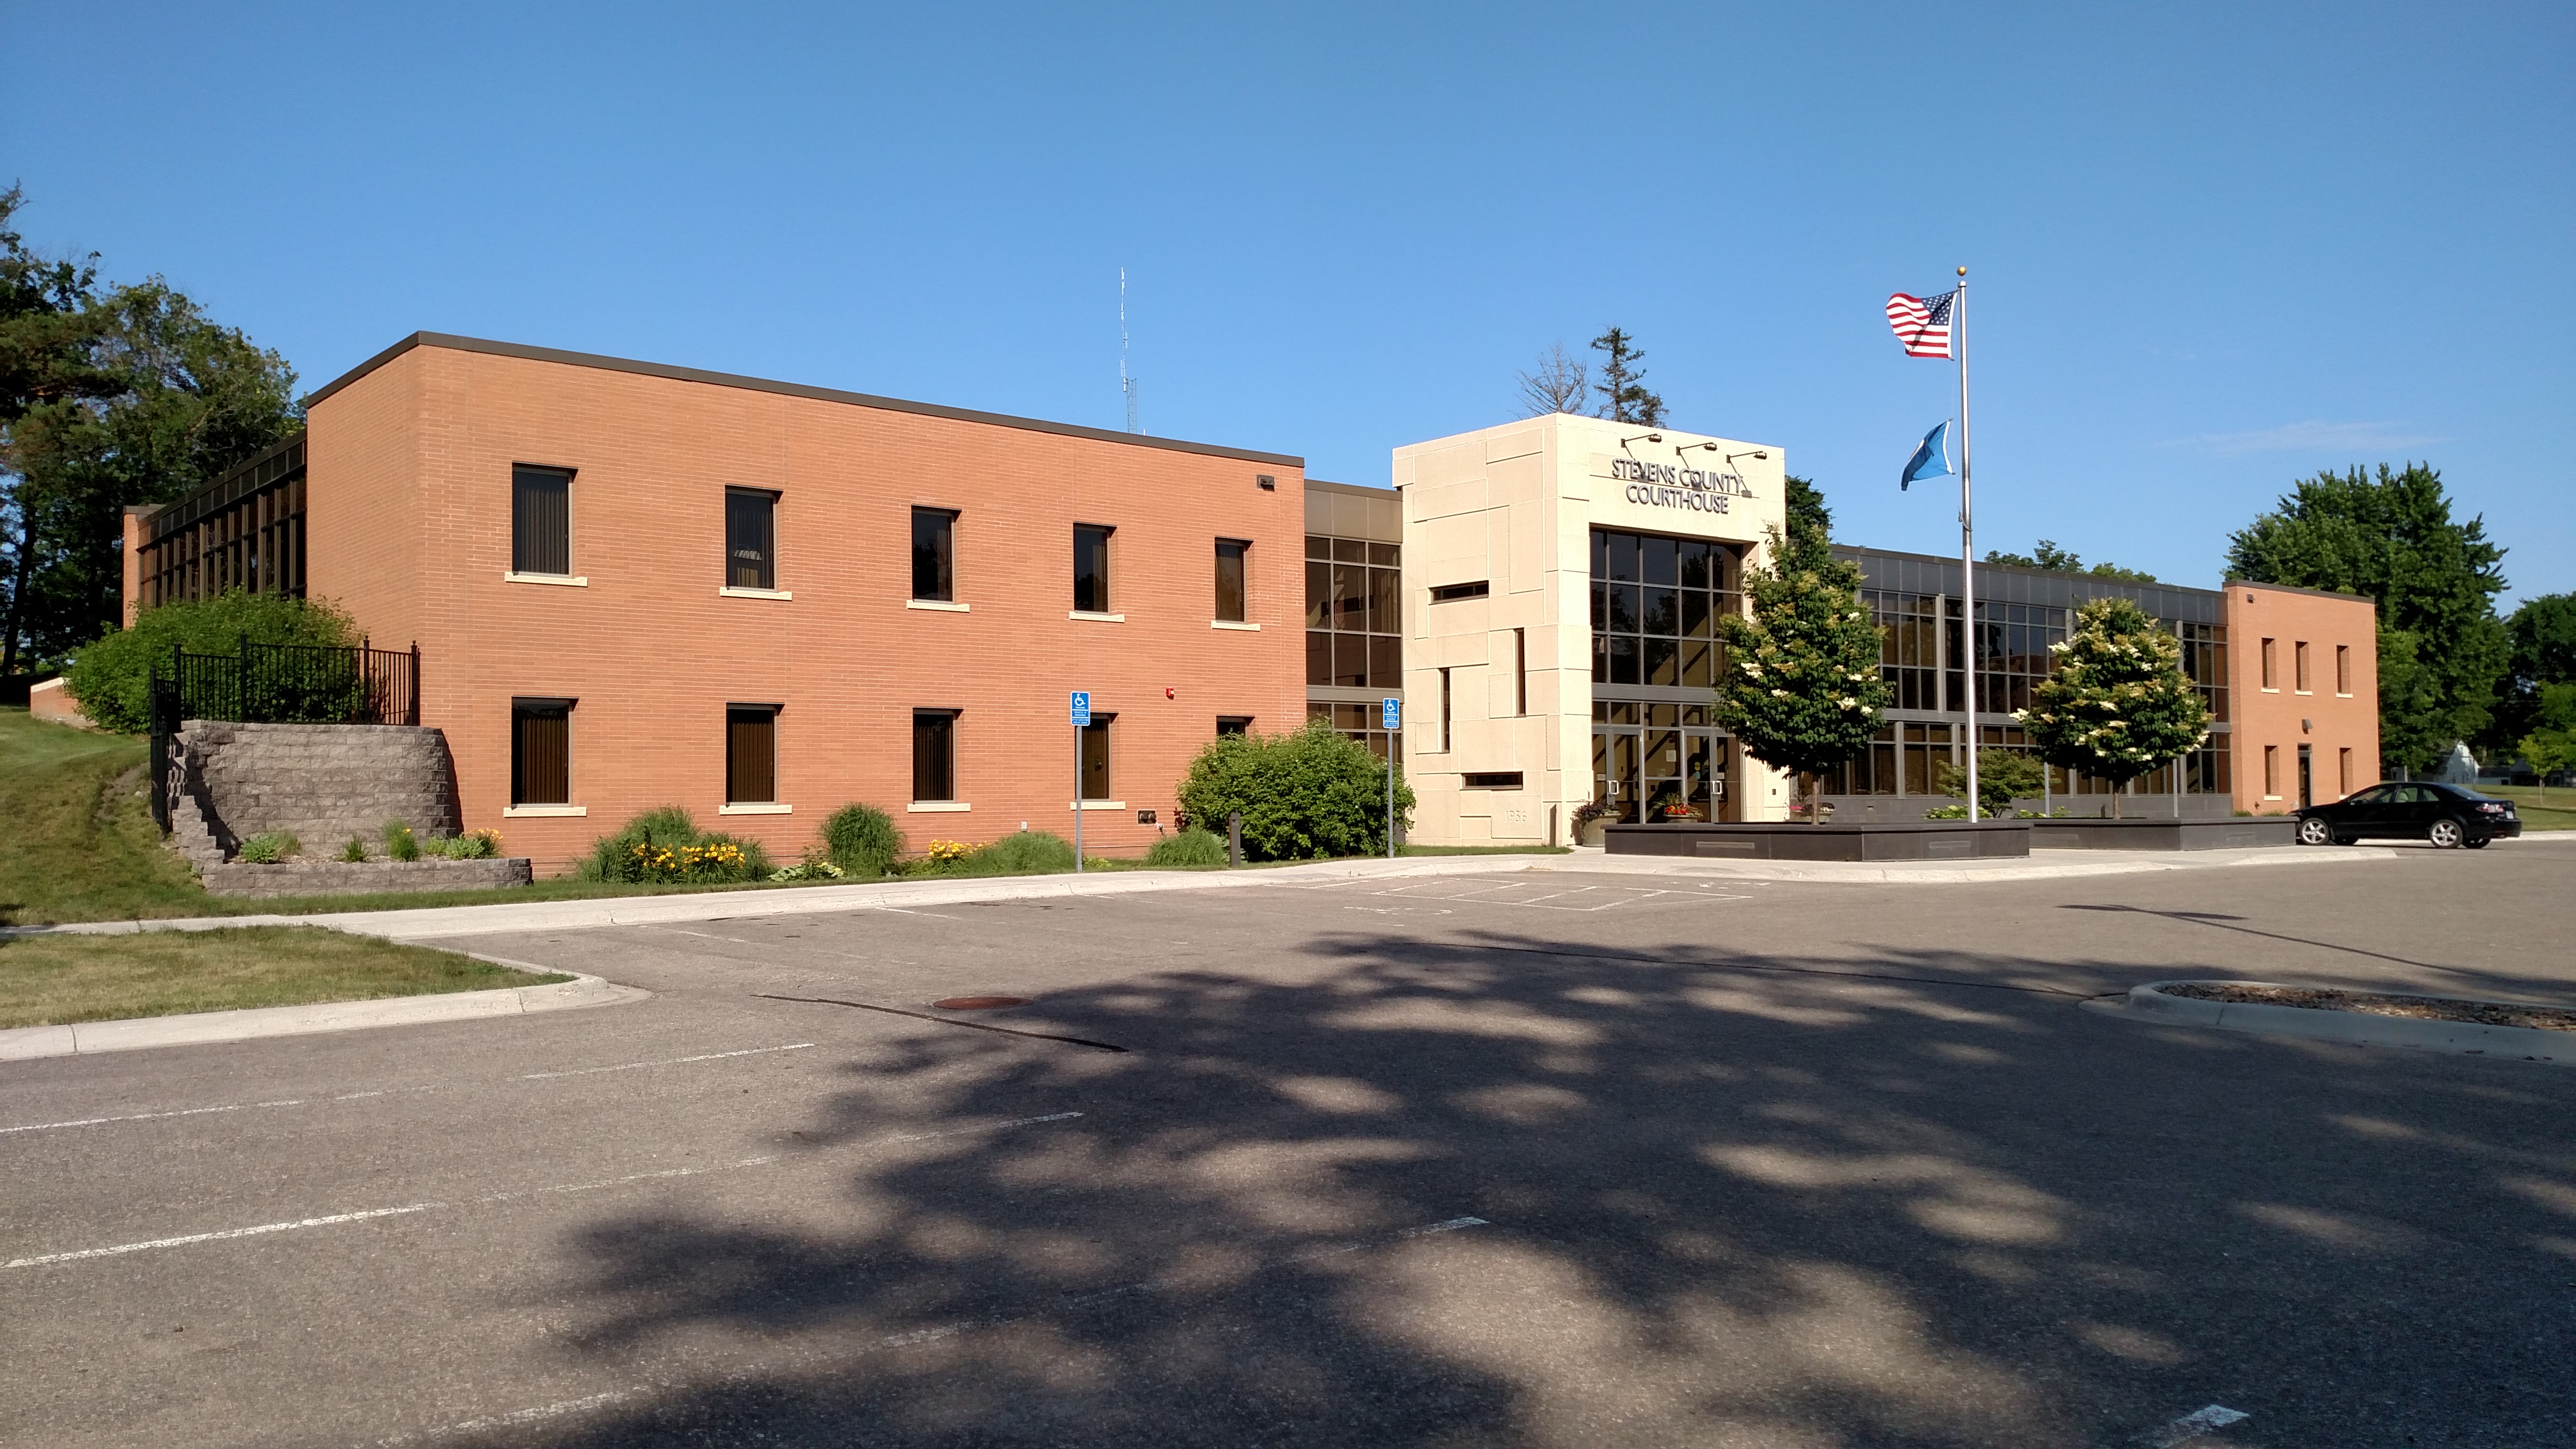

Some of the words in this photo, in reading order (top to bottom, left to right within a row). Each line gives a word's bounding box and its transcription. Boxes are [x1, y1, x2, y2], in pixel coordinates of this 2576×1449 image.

[1612, 458, 1676, 485] STEVENS
[1679, 468, 1743, 494] COUNTY
[1626, 484, 1729, 514] COURTHOUSE
[1505, 810, 1527, 822] 1956
